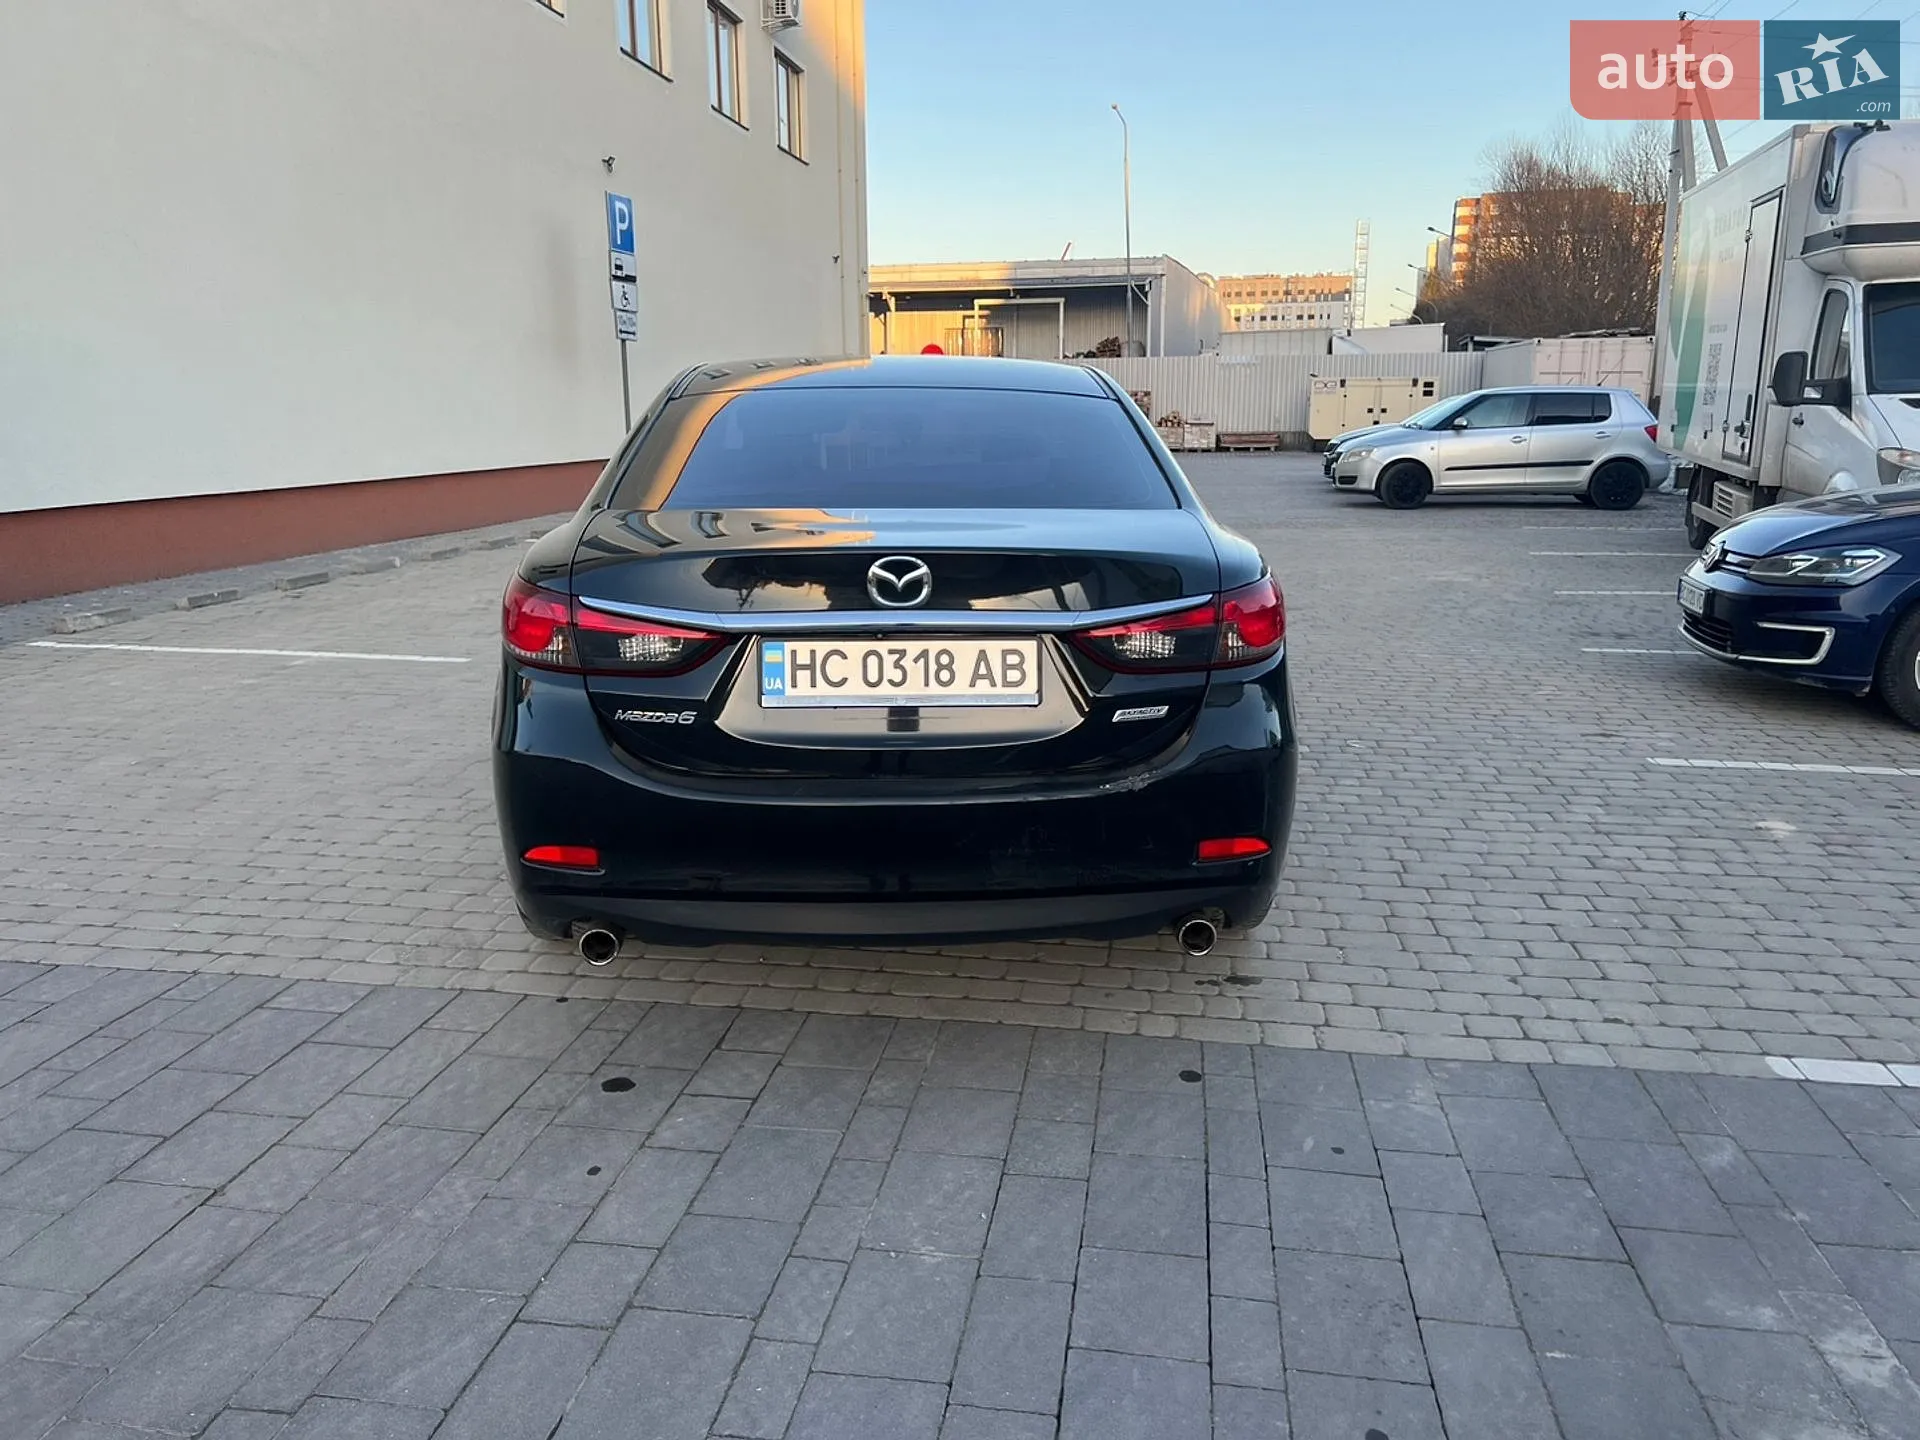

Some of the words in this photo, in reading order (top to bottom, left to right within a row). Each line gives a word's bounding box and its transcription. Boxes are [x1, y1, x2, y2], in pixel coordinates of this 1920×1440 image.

[614, 200, 630, 245] P
[765, 677, 783, 689] UA
[790, 648, 848, 688] HC
[861, 648, 956, 688] 0318
[968, 648, 1027, 688] AB
